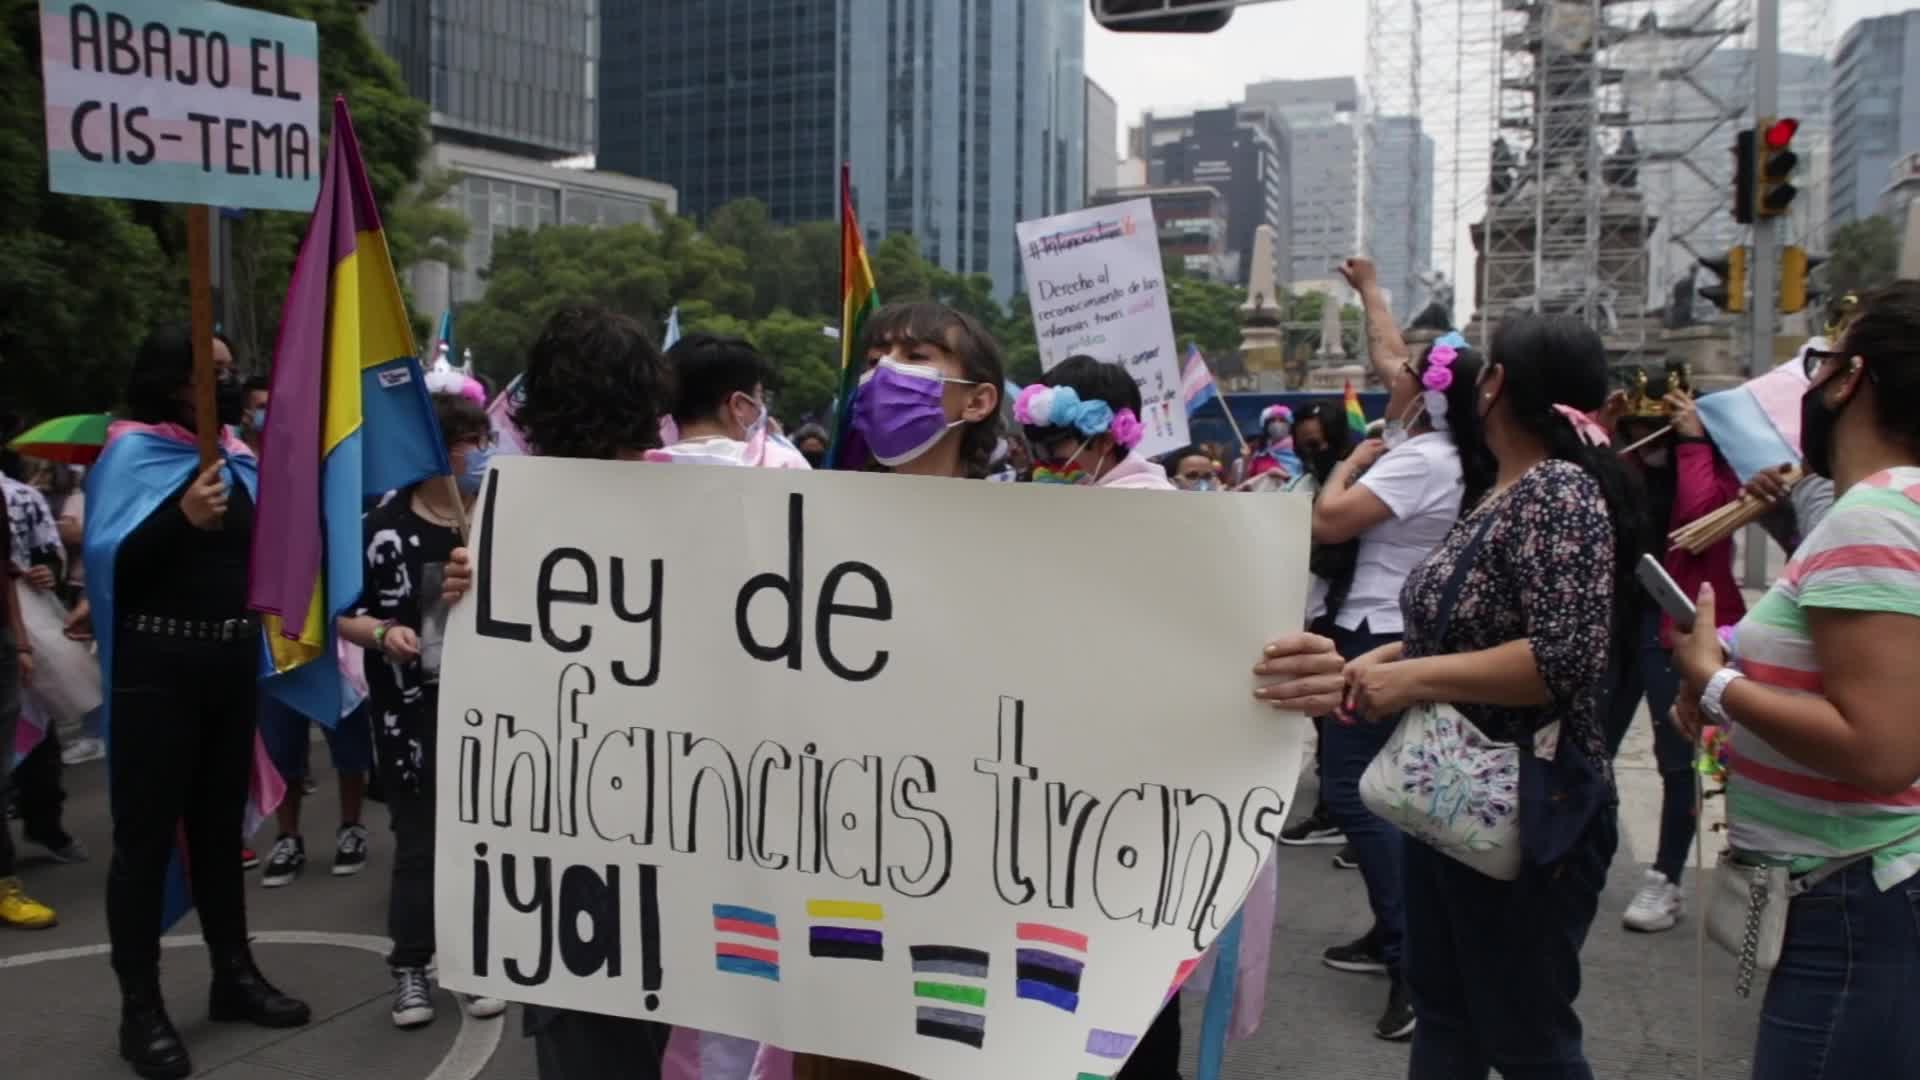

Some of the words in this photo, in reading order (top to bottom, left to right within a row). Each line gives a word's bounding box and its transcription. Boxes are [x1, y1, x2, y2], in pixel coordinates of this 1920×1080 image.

[69, 3, 230, 89] ABAJO
[250, 37, 301, 101] EL
[71, 100, 310, 181] CIS-TEMA
[1038, 272, 1094, 300] Derecho
[1097, 263, 1109, 285] al
[1128, 281, 1140, 294] de
[475, 469, 663, 686] Ley
[735, 492, 892, 681] de
[458, 663, 953, 897] infancias
[973, 695, 1285, 950] trans
